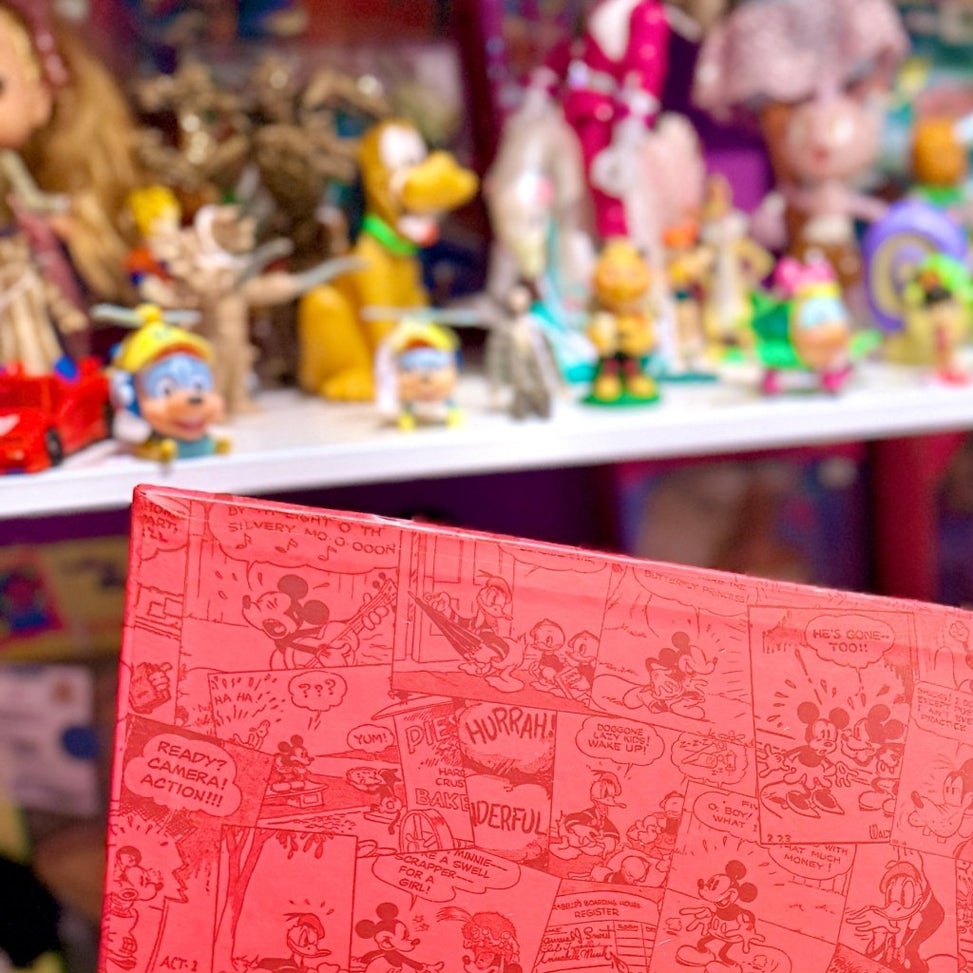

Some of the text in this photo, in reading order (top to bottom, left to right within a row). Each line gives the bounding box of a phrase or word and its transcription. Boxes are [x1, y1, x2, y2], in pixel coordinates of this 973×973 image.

[227, 520, 296, 533] SILVERY
[812, 629, 841, 640] HE'S
[828, 641, 868, 653] TOO!!
[465, 706, 557, 745] HURRAH!
[597, 723, 644, 736] DOGGONE
[353, 732, 388, 744] YUM!
[593, 732, 619, 741] LAZY
[588, 739, 647, 756] WAKE UP!
[157, 740, 228, 772] READY?
[147, 757, 228, 790] CAMERA!
[140, 773, 223, 808] ACTION!!!
[725, 806, 753, 820] BOY!
[712, 814, 746, 830] WHAT
[811, 850, 842, 865] MUCH
[398, 865, 435, 884] FOR A
[453, 860, 490, 879] SWELL
[398, 878, 431, 894] GIRL!
[574, 908, 619, 918] REGISTER
